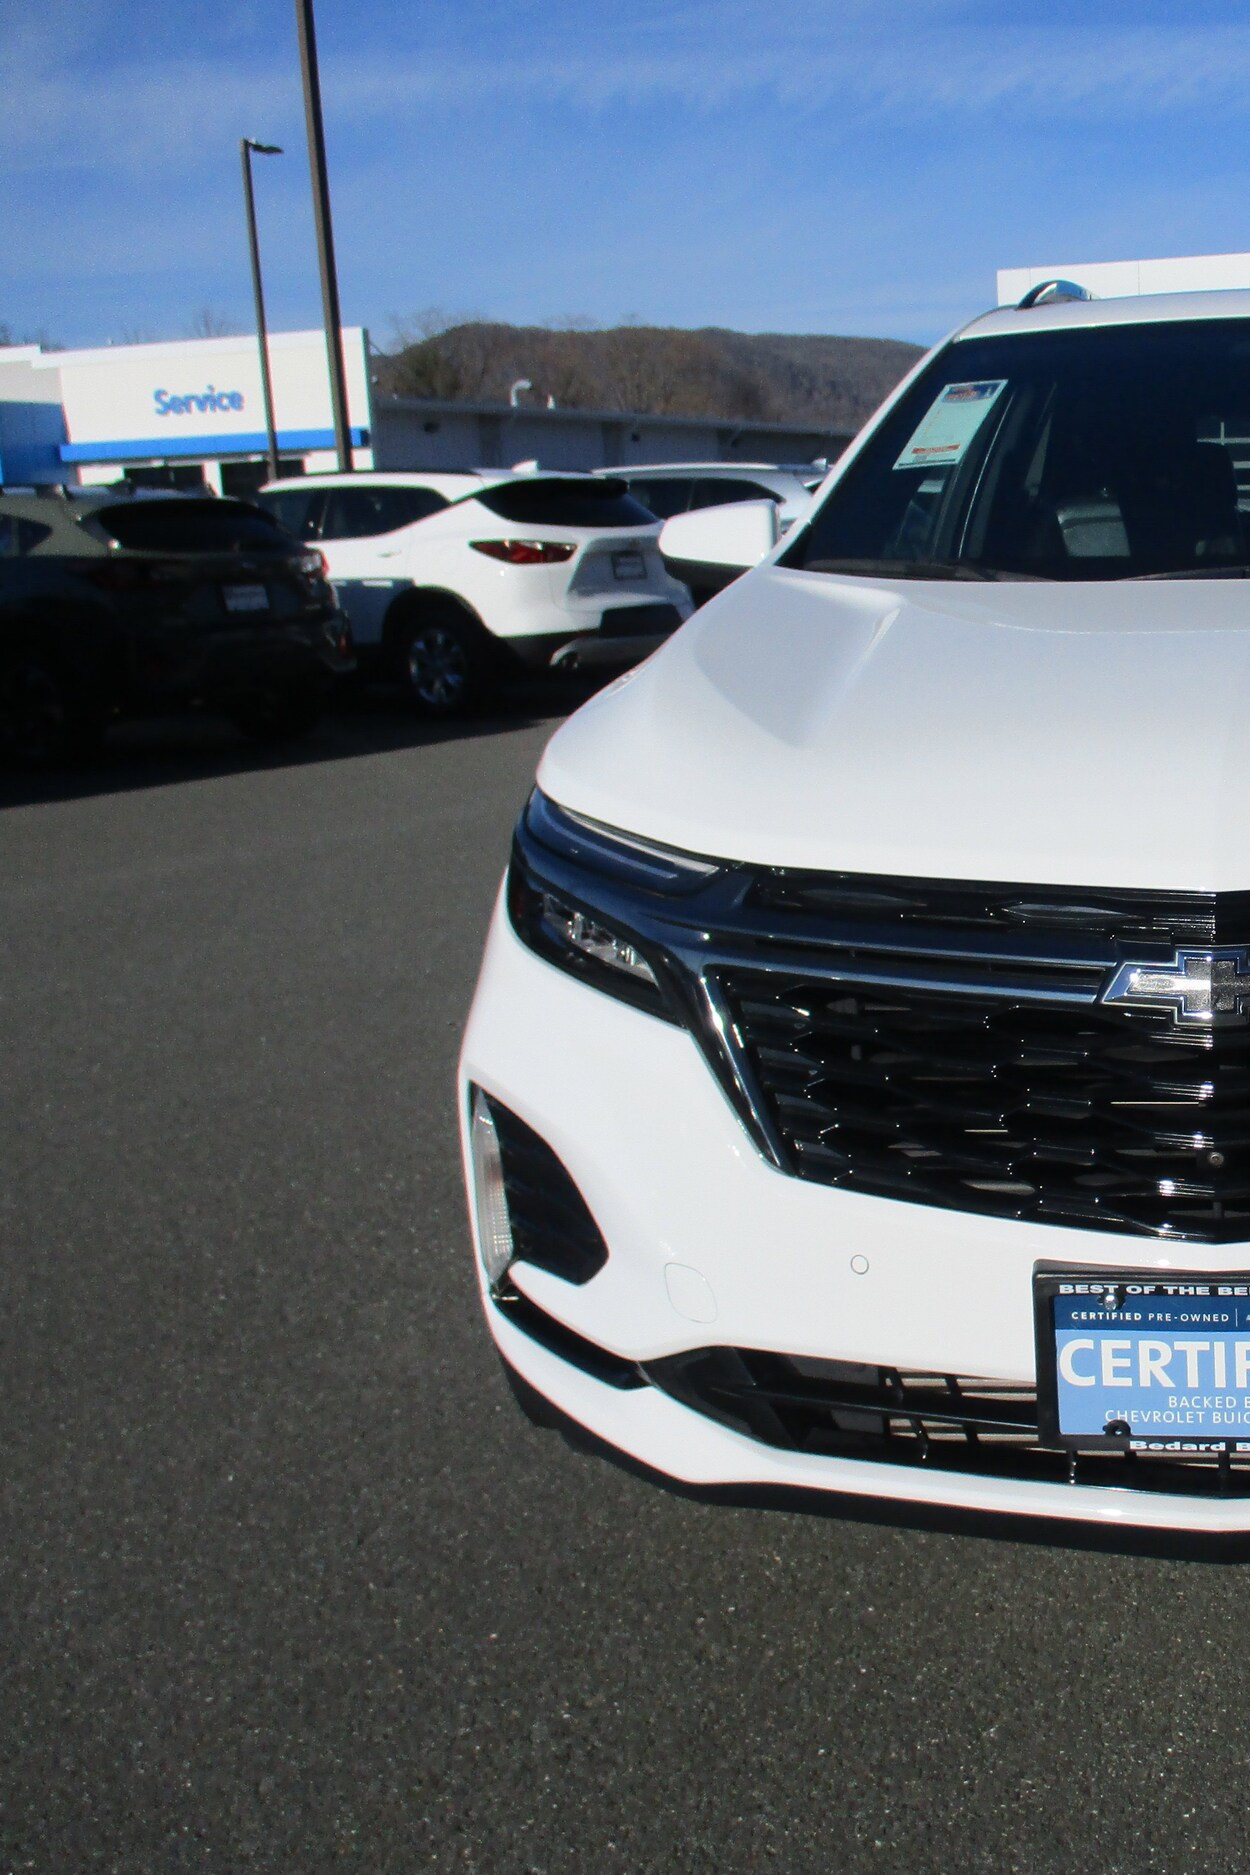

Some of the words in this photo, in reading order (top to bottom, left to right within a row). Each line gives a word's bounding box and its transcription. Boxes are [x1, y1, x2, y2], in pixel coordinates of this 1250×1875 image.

[154, 384, 244, 415] Service
[1060, 1284, 1118, 1295] BEST
[1126, 1285, 1156, 1296] OF
[1163, 1285, 1210, 1296] THE
[1071, 1311, 1142, 1321] CERTIFIED
[1148, 1313, 1229, 1322] PRE-OWNED
[1168, 1396, 1238, 1409] BACKED
[1105, 1410, 1204, 1424] CHEVROLET
[1129, 1440, 1226, 1452] Bedard
